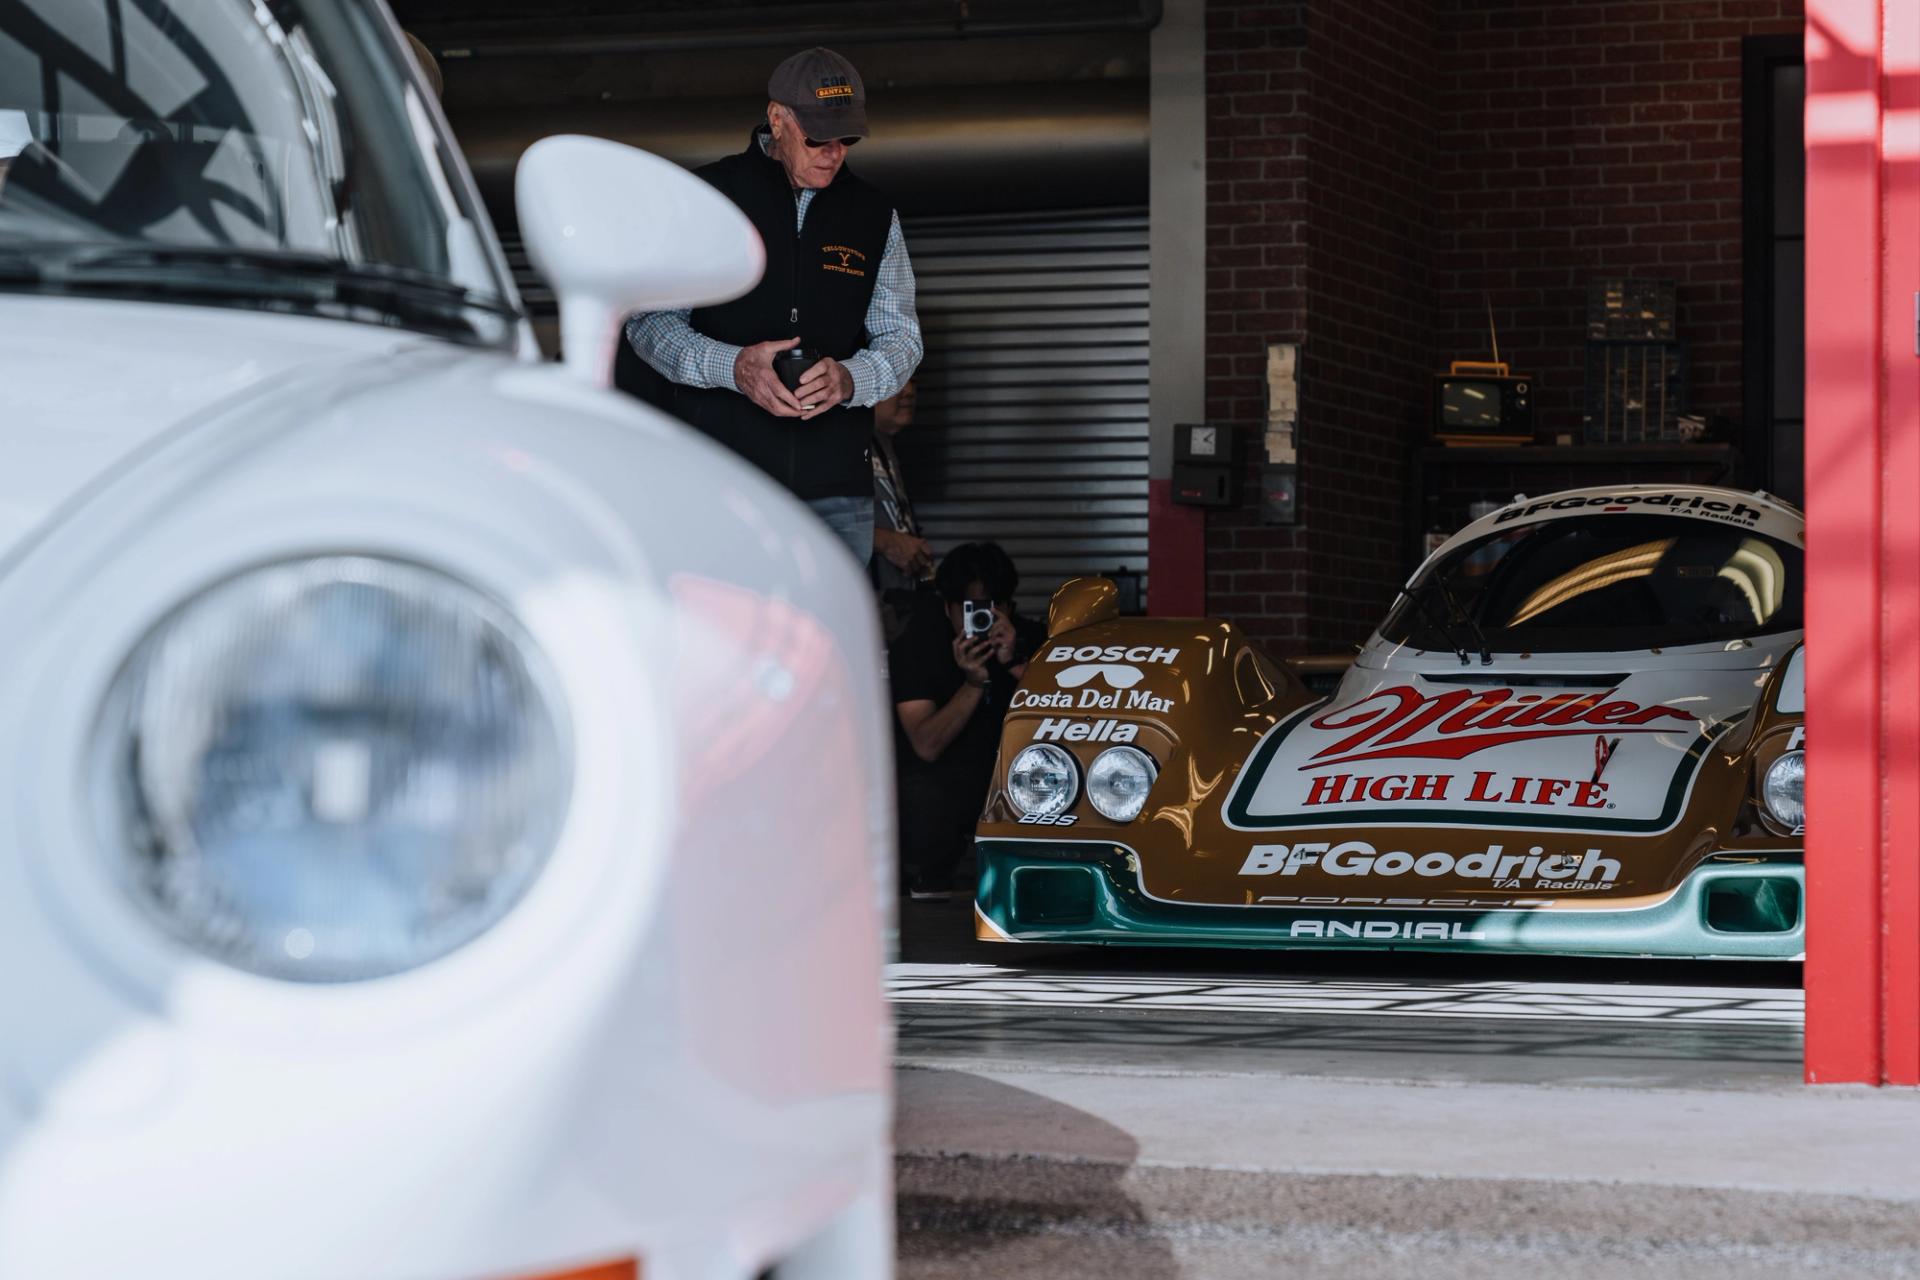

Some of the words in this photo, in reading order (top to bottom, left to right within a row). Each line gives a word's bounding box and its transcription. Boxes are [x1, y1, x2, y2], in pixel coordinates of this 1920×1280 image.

[819, 88, 842, 97] SANTA
[1493, 494, 1761, 525] BFGoodrich
[1668, 507, 1694, 516] T/A
[1699, 511, 1755, 527] Radials
[1045, 646, 1181, 664] BOSCH
[1009, 689, 1074, 709] Costa
[1077, 689, 1123, 709] Del
[1125, 689, 1175, 713] Mar
[1032, 718, 1139, 743] Hella
[1302, 685, 1701, 768] Miller
[1302, 774, 1453, 806] HIGH
[1018, 812, 1078, 826] BBS
[1238, 842, 1621, 881] BFGoodrich
[1492, 879, 1521, 888] T/A
[1535, 879, 1613, 890] Radials
[1290, 920, 1485, 940] ANDIAL
